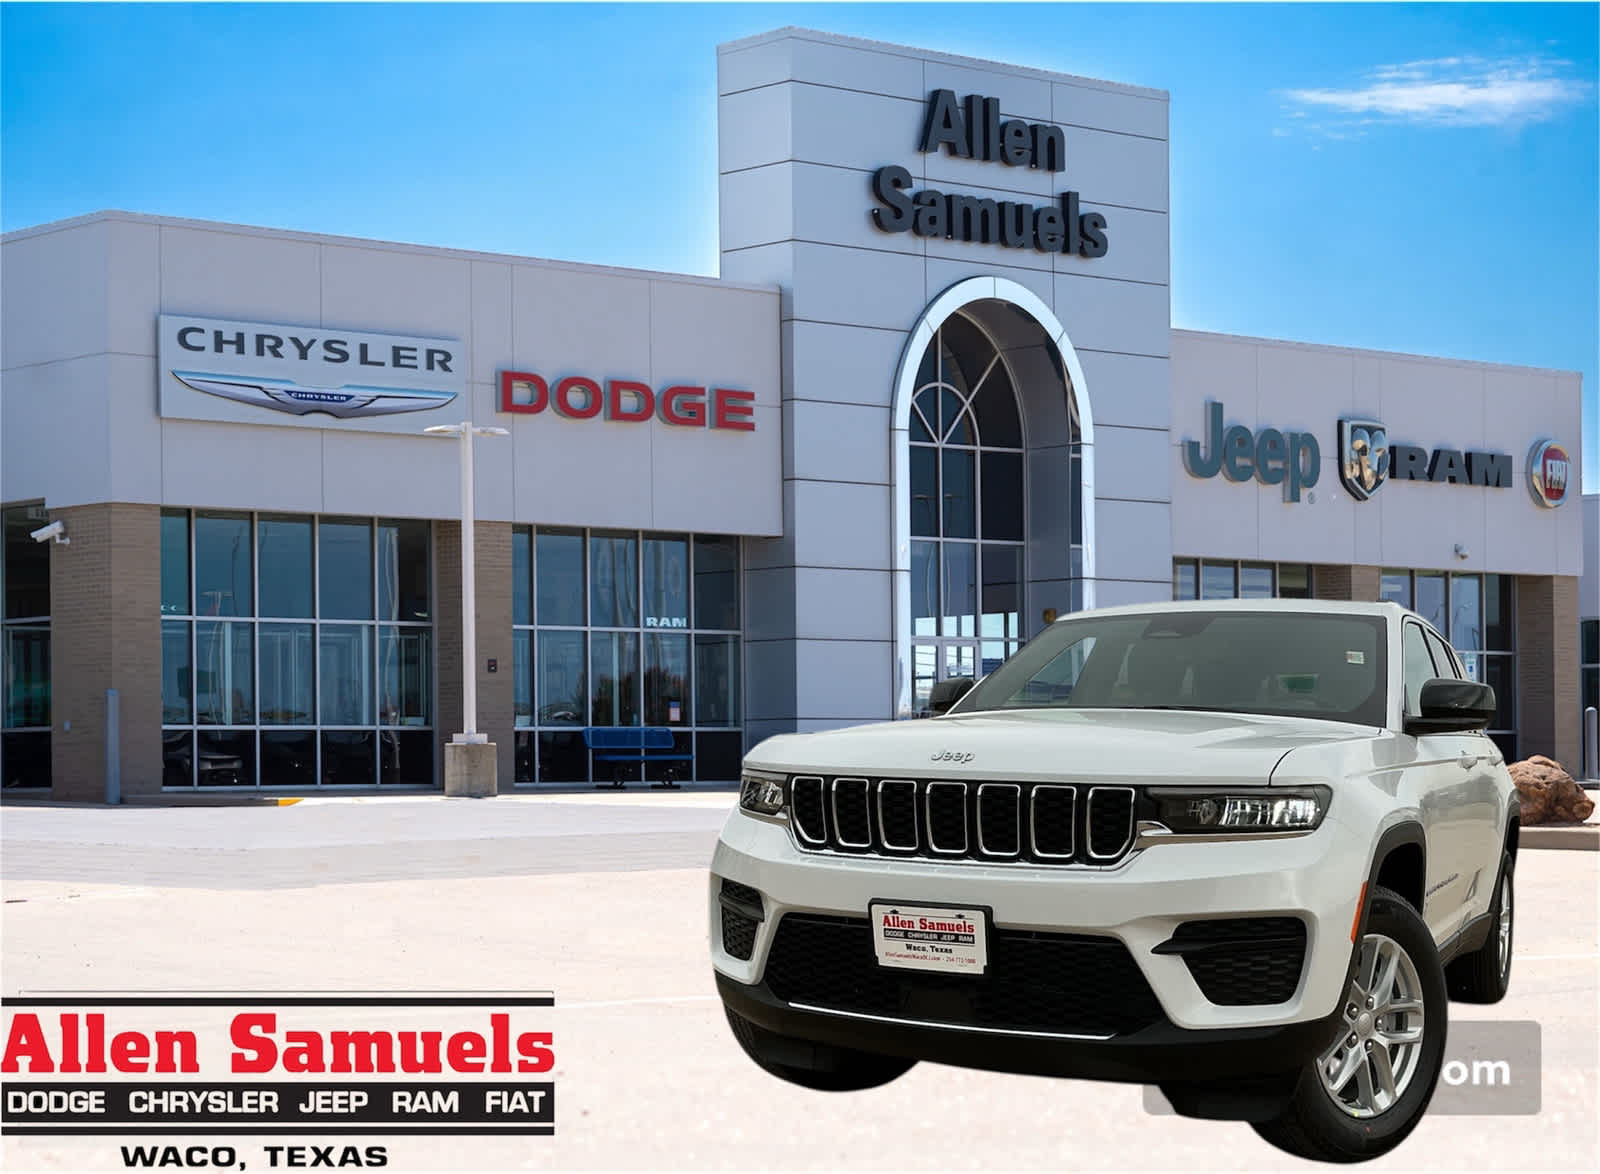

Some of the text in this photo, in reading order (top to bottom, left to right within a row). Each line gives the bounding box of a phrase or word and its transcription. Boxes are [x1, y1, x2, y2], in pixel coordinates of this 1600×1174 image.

[918, 88, 1066, 172] Allen
[872, 165, 1108, 258] Samuels
[176, 325, 454, 373] CHRYSLER
[290, 391, 348, 402] CHRYSLER
[496, 370, 755, 432] DODGE
[1183, 401, 1321, 503] Jeep
[1389, 444, 1513, 489] RAM
[645, 616, 687, 628] RAM
[931, 748, 976, 764] Jeep
[883, 915, 974, 933] Allen Samuels
[907, 932, 938, 940] CHRYSLER
